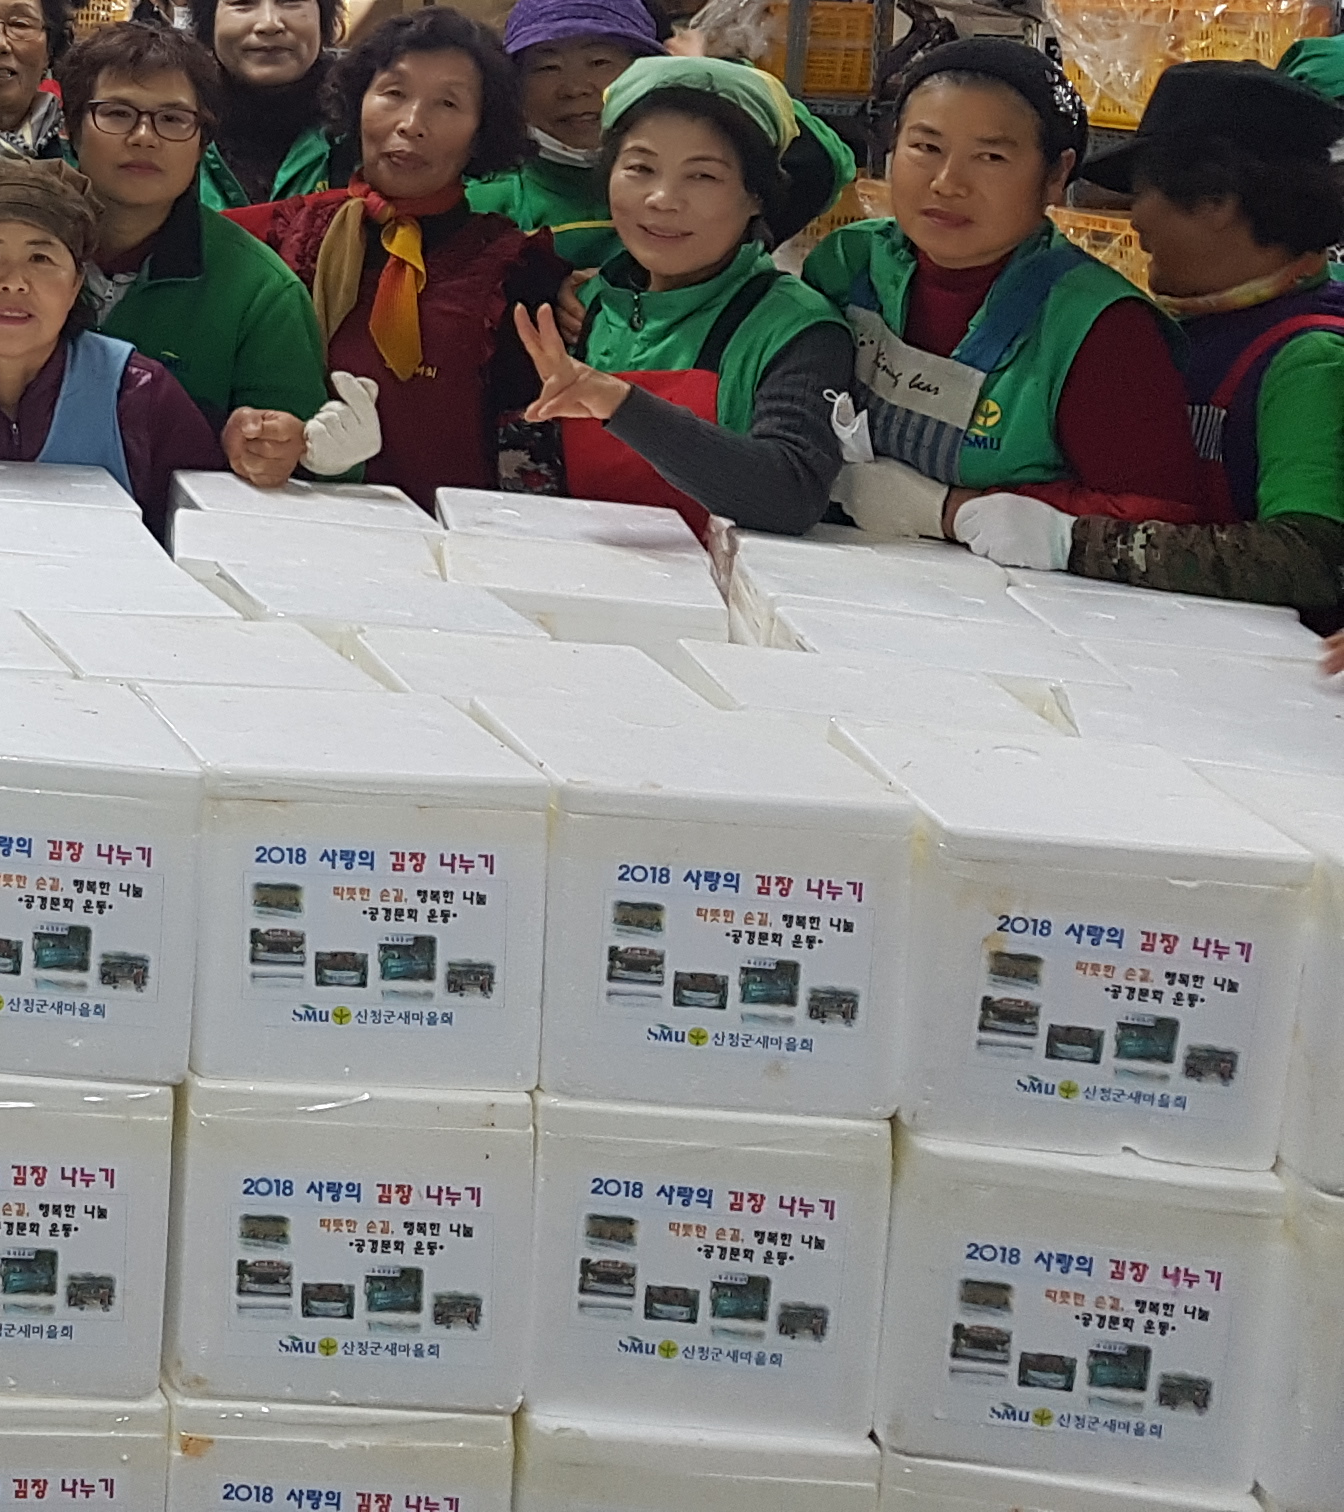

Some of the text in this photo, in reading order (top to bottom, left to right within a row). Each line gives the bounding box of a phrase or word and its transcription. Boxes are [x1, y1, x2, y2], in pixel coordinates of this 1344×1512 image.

[45, 839, 84, 863] 김장
[95, 843, 152, 869] 나누기
[254, 846, 495, 876] 2018 사랑의 김장 나누기
[616, 864, 864, 904] 2018 사랑의 김장 나누기
[995, 914, 1253, 964] 2018 사랑의 김장 나누기
[6, 996, 106, 1019] 산청군새마을회
[646, 1025, 814, 1054] SMU 산청군새마을회
[10, 1165, 48, 1187] 김장
[60, 1167, 116, 1190] 나누기
[241, 1178, 482, 1208] 2018 사랑의 김장 나누기
[589, 1177, 837, 1221] 2018 사랑의 김장 나누기
[964, 1242, 1223, 1292] 2018 사랑의 김장 나누기
[11, 1478, 49, 1499] 김장
[60, 1479, 116, 1500] 나누기
